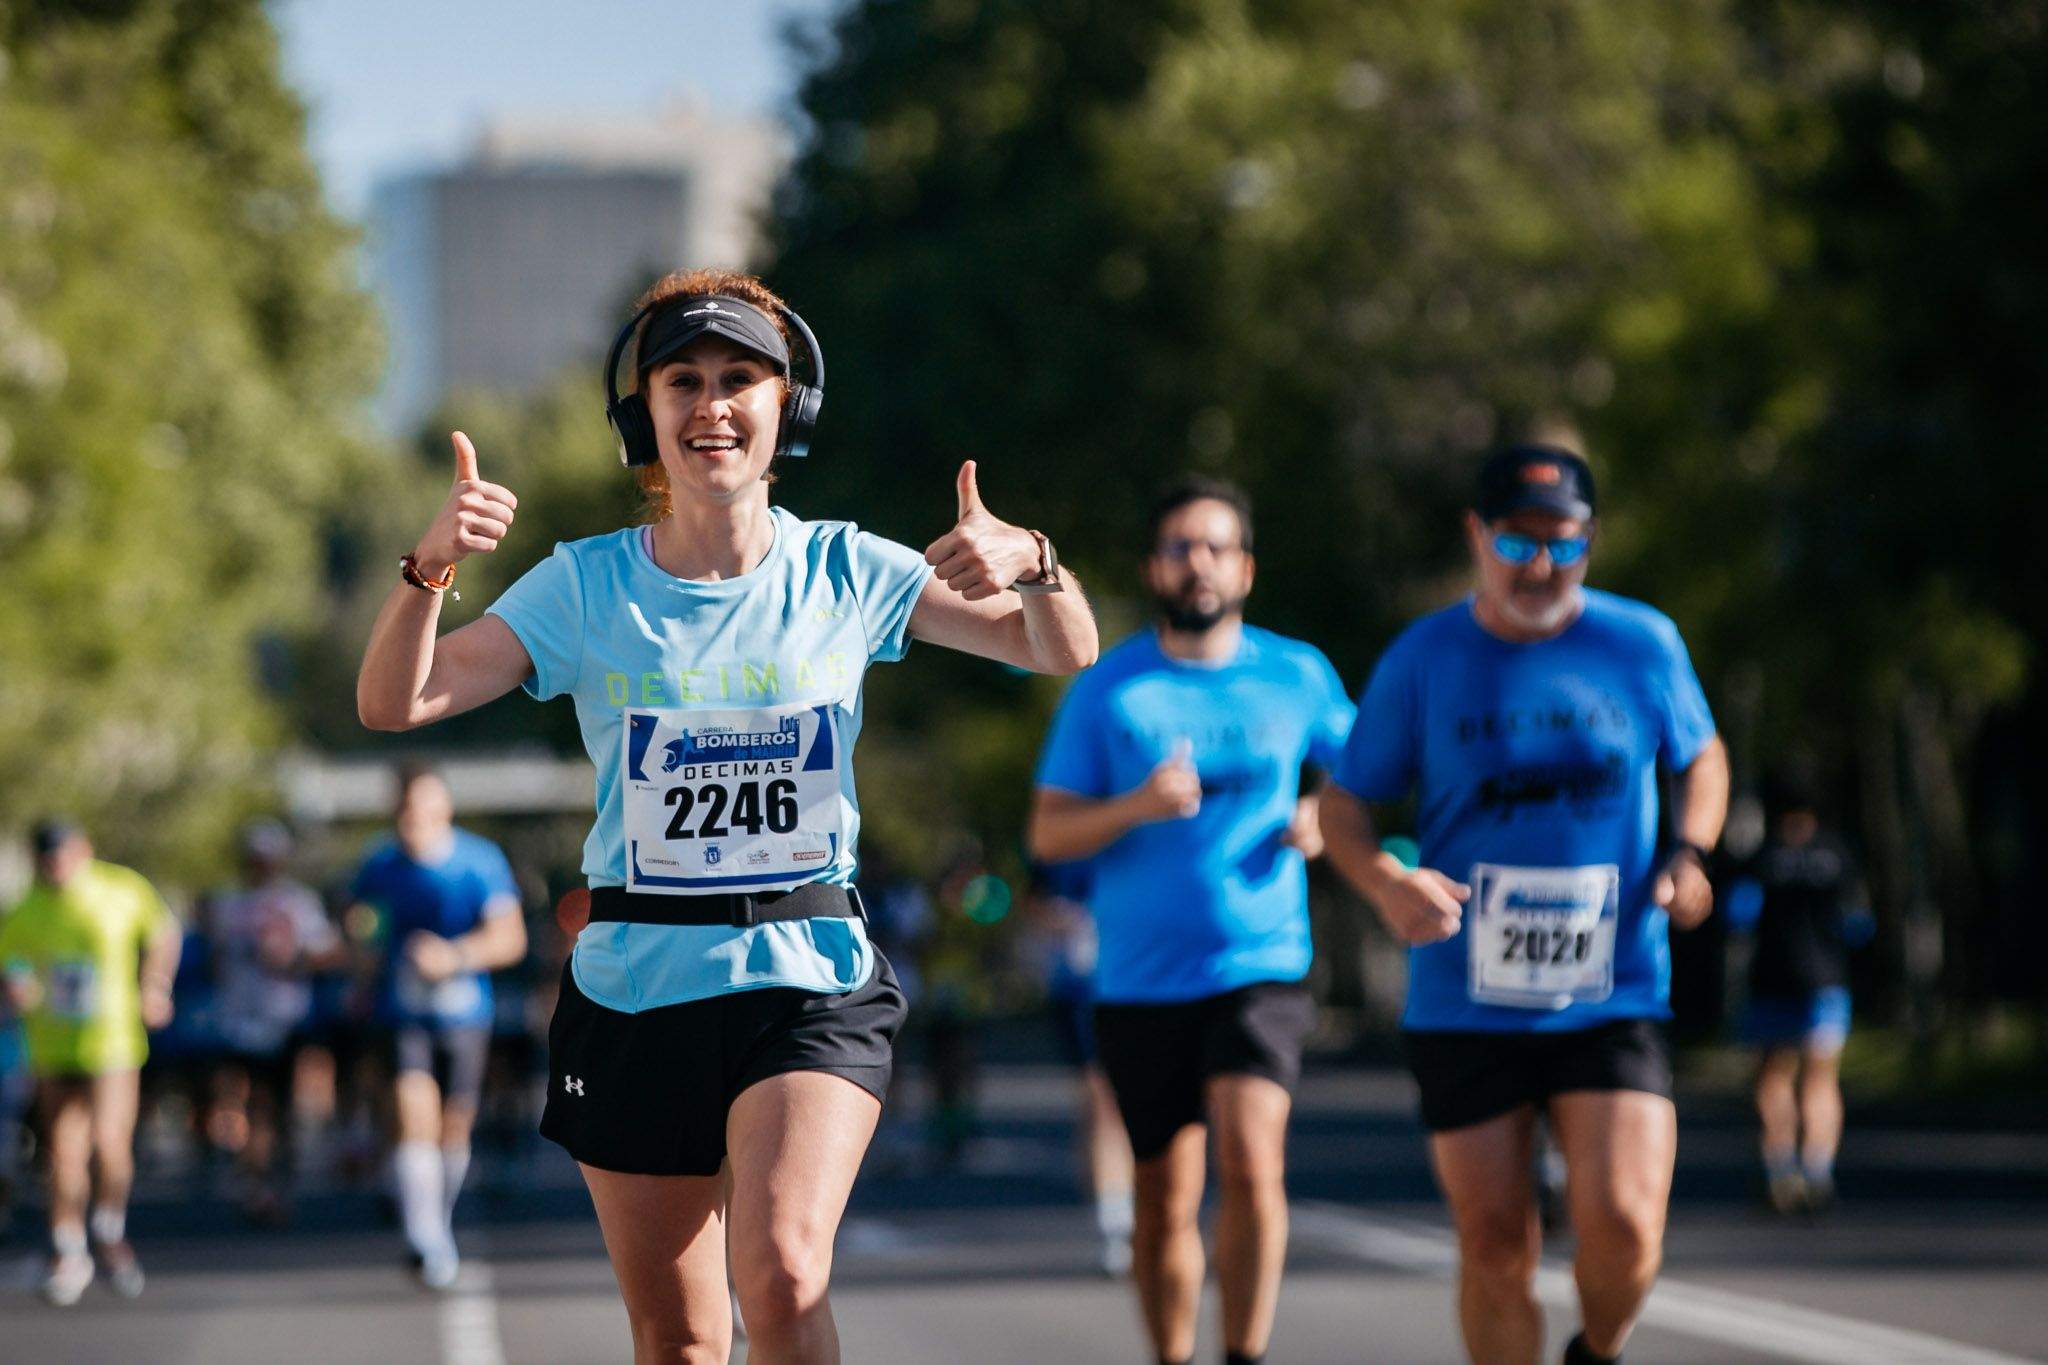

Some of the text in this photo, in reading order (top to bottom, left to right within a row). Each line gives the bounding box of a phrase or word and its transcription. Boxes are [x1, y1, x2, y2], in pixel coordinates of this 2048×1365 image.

[606, 653, 848, 706] DECIMAS
[696, 732, 796, 749] BOMBEROS
[684, 760, 793, 780] DECIMAS
[664, 779, 798, 840] 2246
